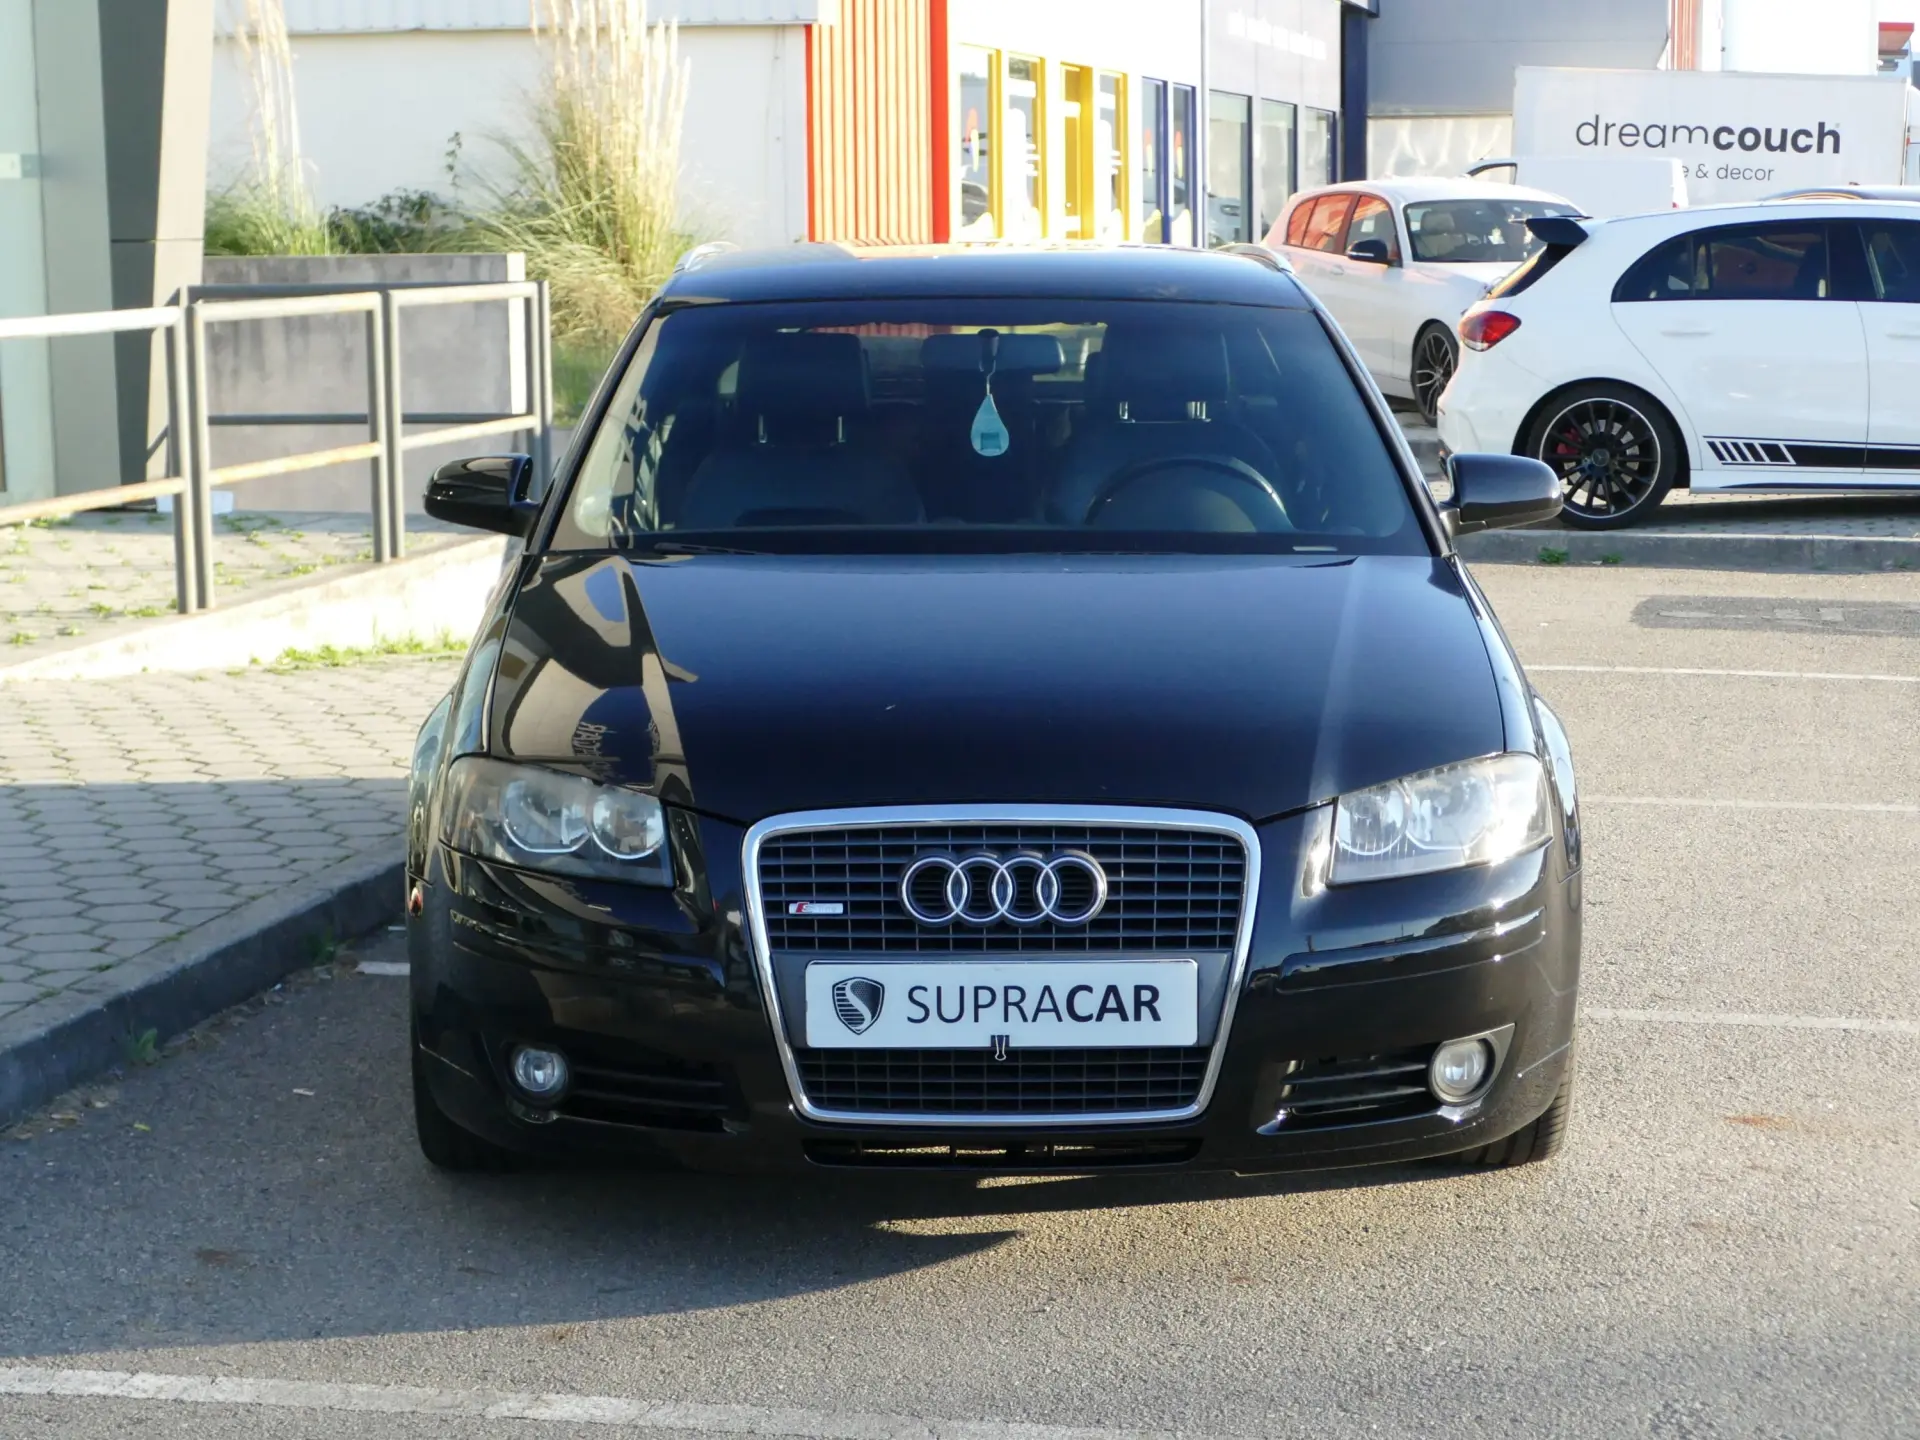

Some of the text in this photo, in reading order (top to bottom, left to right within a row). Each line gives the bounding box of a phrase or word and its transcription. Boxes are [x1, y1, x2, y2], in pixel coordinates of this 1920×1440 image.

[1576, 114, 1840, 154] dreamcouch
[1695, 163, 1709, 179] &
[1716, 163, 1775, 181] decor
[906, 984, 1162, 1024] SUPRACAR
